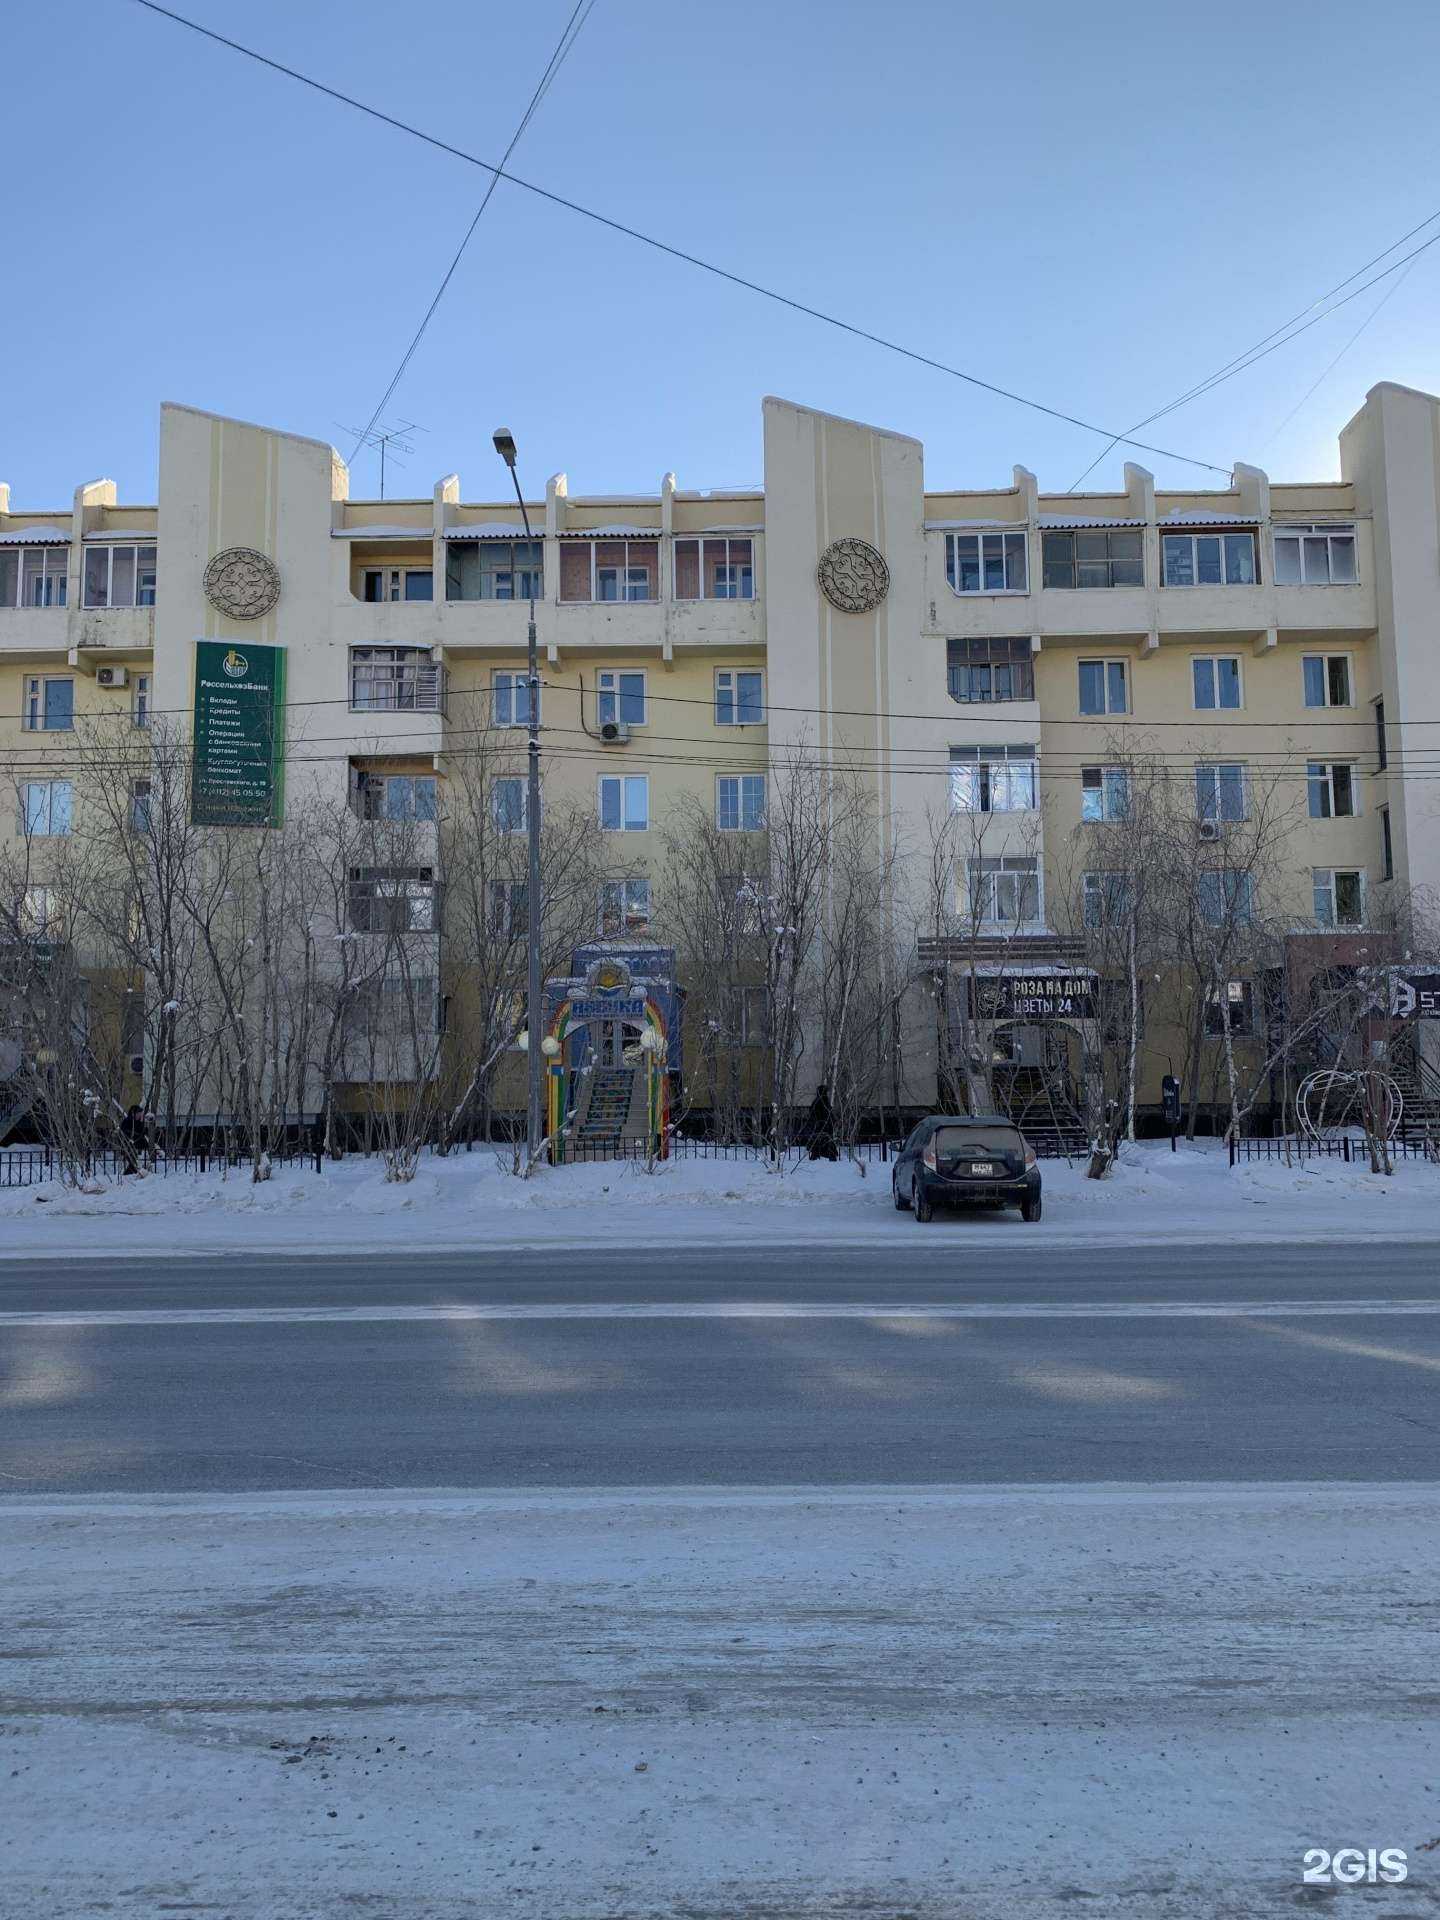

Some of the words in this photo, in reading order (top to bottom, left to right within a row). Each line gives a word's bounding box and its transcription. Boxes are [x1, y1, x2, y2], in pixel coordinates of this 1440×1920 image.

[201, 680, 269, 690] РоссельхозБанк
[209, 707, 240, 715] Кредиты
[1014, 981, 1044, 995] РОЗА
[1046, 981, 1062, 995] НА
[1064, 980, 1091, 996] ДОМ
[1014, 999, 1053, 1013] ЦВЕТЫ
[1058, 999, 1072, 1012] 24
